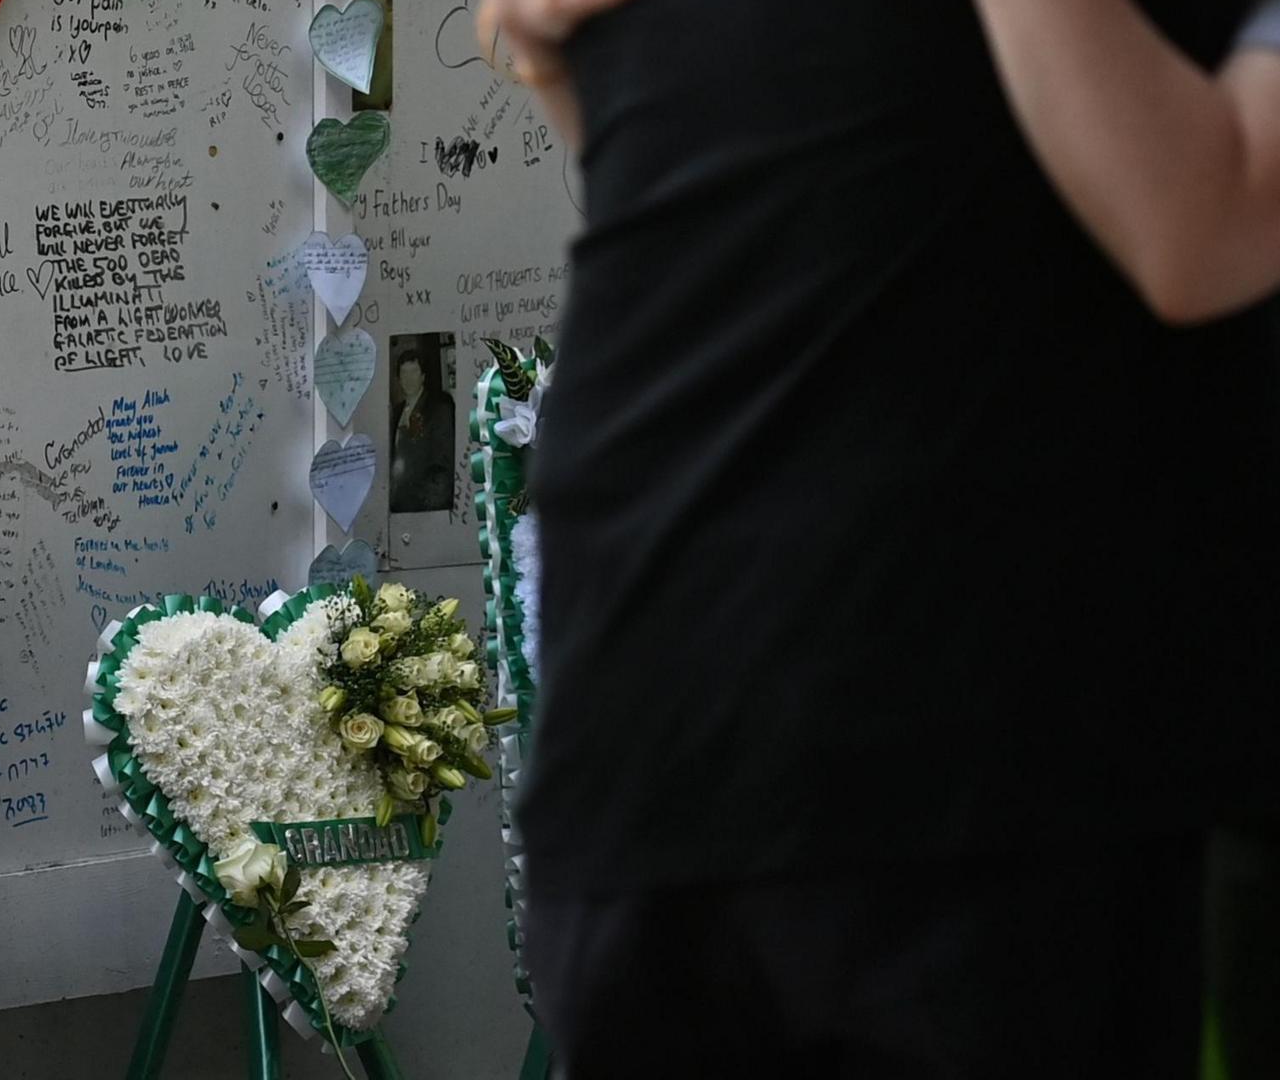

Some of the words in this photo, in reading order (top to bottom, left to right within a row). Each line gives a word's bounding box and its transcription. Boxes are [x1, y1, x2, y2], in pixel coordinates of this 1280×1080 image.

[51, 15, 62, 32] is
[522, 124, 548, 157] RIP
[35, 204, 61, 222] WE
[65, 199, 95, 219] WILL
[99, 191, 187, 226] EVENTUALLY
[372, 189, 429, 220] Fathers
[436, 182, 462, 215] Day
[102, 216, 132, 234] BUT
[139, 216, 164, 231] WE
[37, 240, 67, 256] WILL
[73, 234, 125, 255] NEVER
[130, 231, 189, 249] FORGET
[390, 228, 406, 251] All
[408, 234, 431, 257] your
[53, 258, 88, 275] THE
[93, 254, 128, 276] 500
[379, 260, 411, 290] Boys
[111, 273, 137, 291] BY
[143, 266, 186, 284] THE
[54, 314, 91, 333] FROM
[98, 309, 109, 326] A
[53, 328, 128, 352] GALACTIC
[162, 342, 208, 363] LOVE
[142, 388, 171, 410] Allah
[284, 823, 410, 864] GRANDAD
